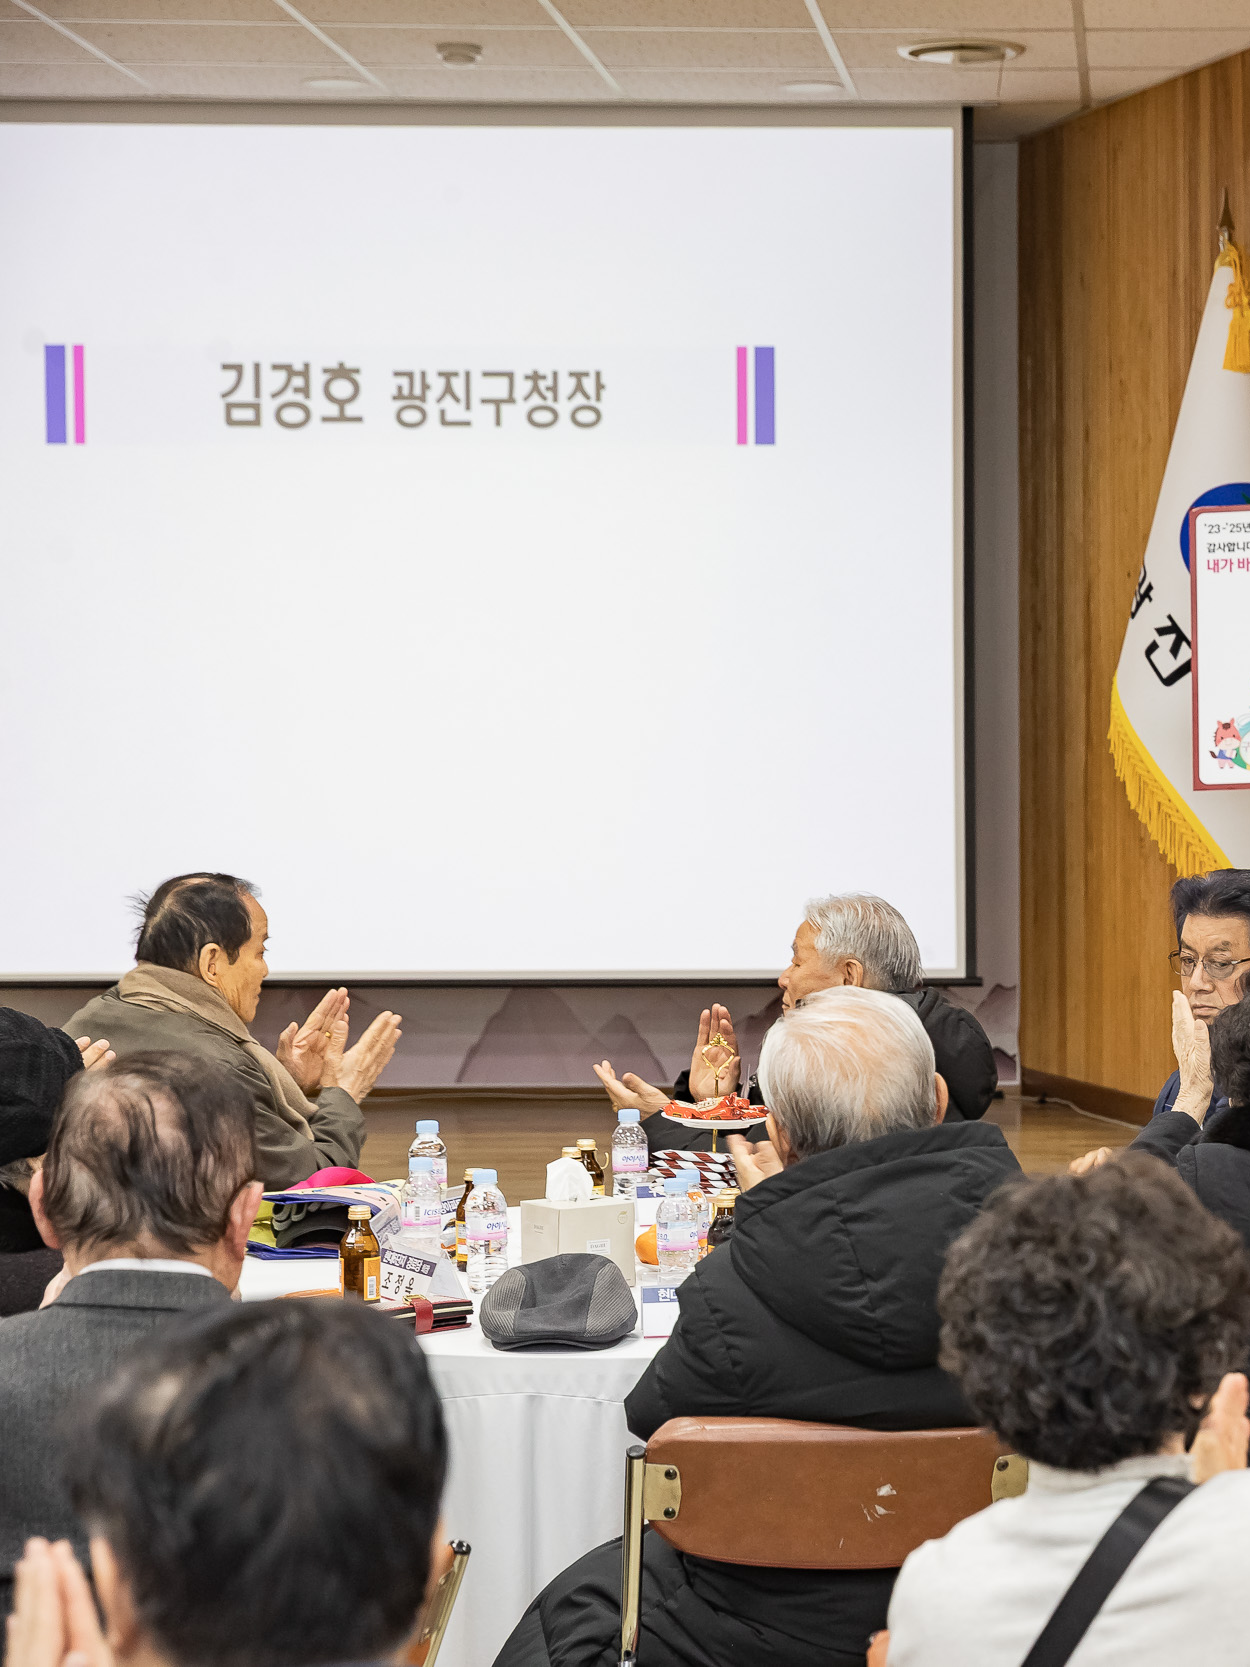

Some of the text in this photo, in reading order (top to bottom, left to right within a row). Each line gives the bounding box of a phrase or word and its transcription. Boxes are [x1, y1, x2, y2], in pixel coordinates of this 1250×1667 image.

[221, 362, 606, 429] 김경호 광진구청장
[1207, 558, 1234, 573] 내가
